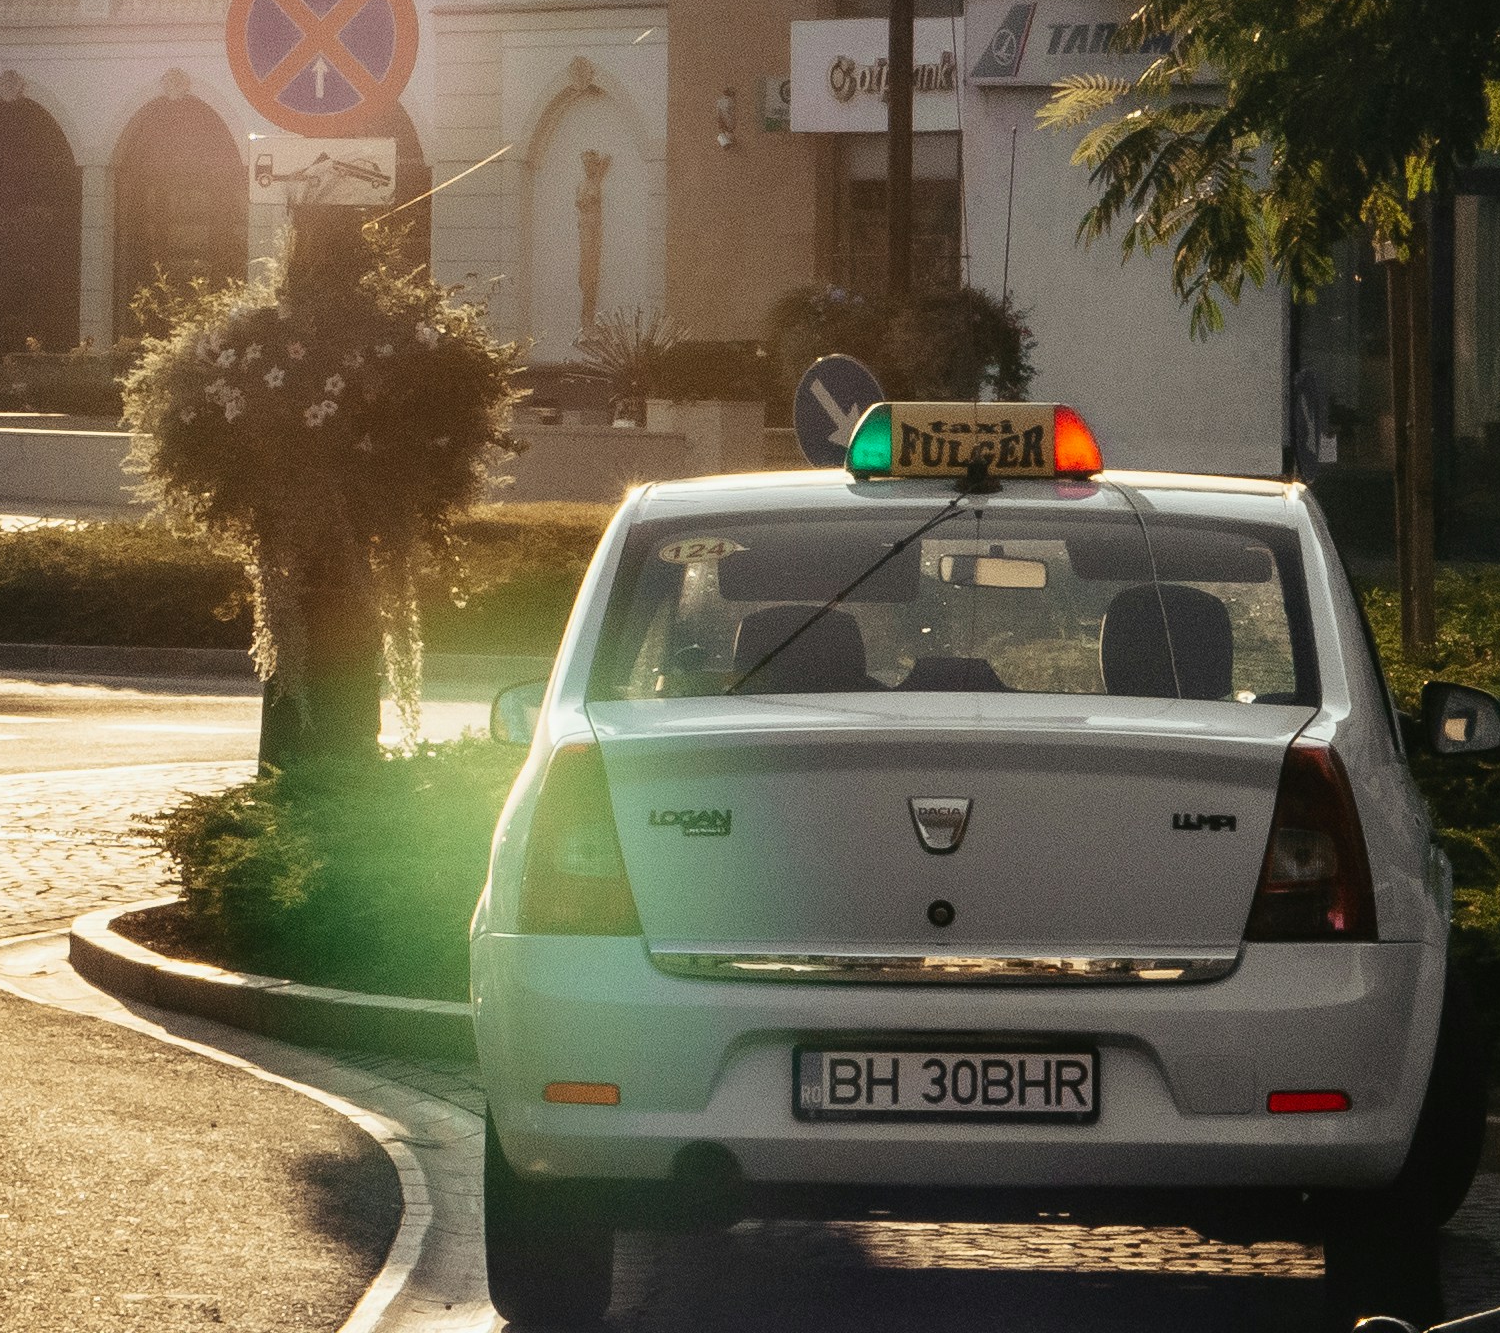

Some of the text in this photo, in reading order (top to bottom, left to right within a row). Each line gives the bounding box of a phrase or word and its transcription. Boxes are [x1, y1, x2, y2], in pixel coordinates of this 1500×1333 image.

[901, 422, 1045, 468] FULGER
[668, 541, 725, 560] 124
[829, 1057, 900, 1105] BH
